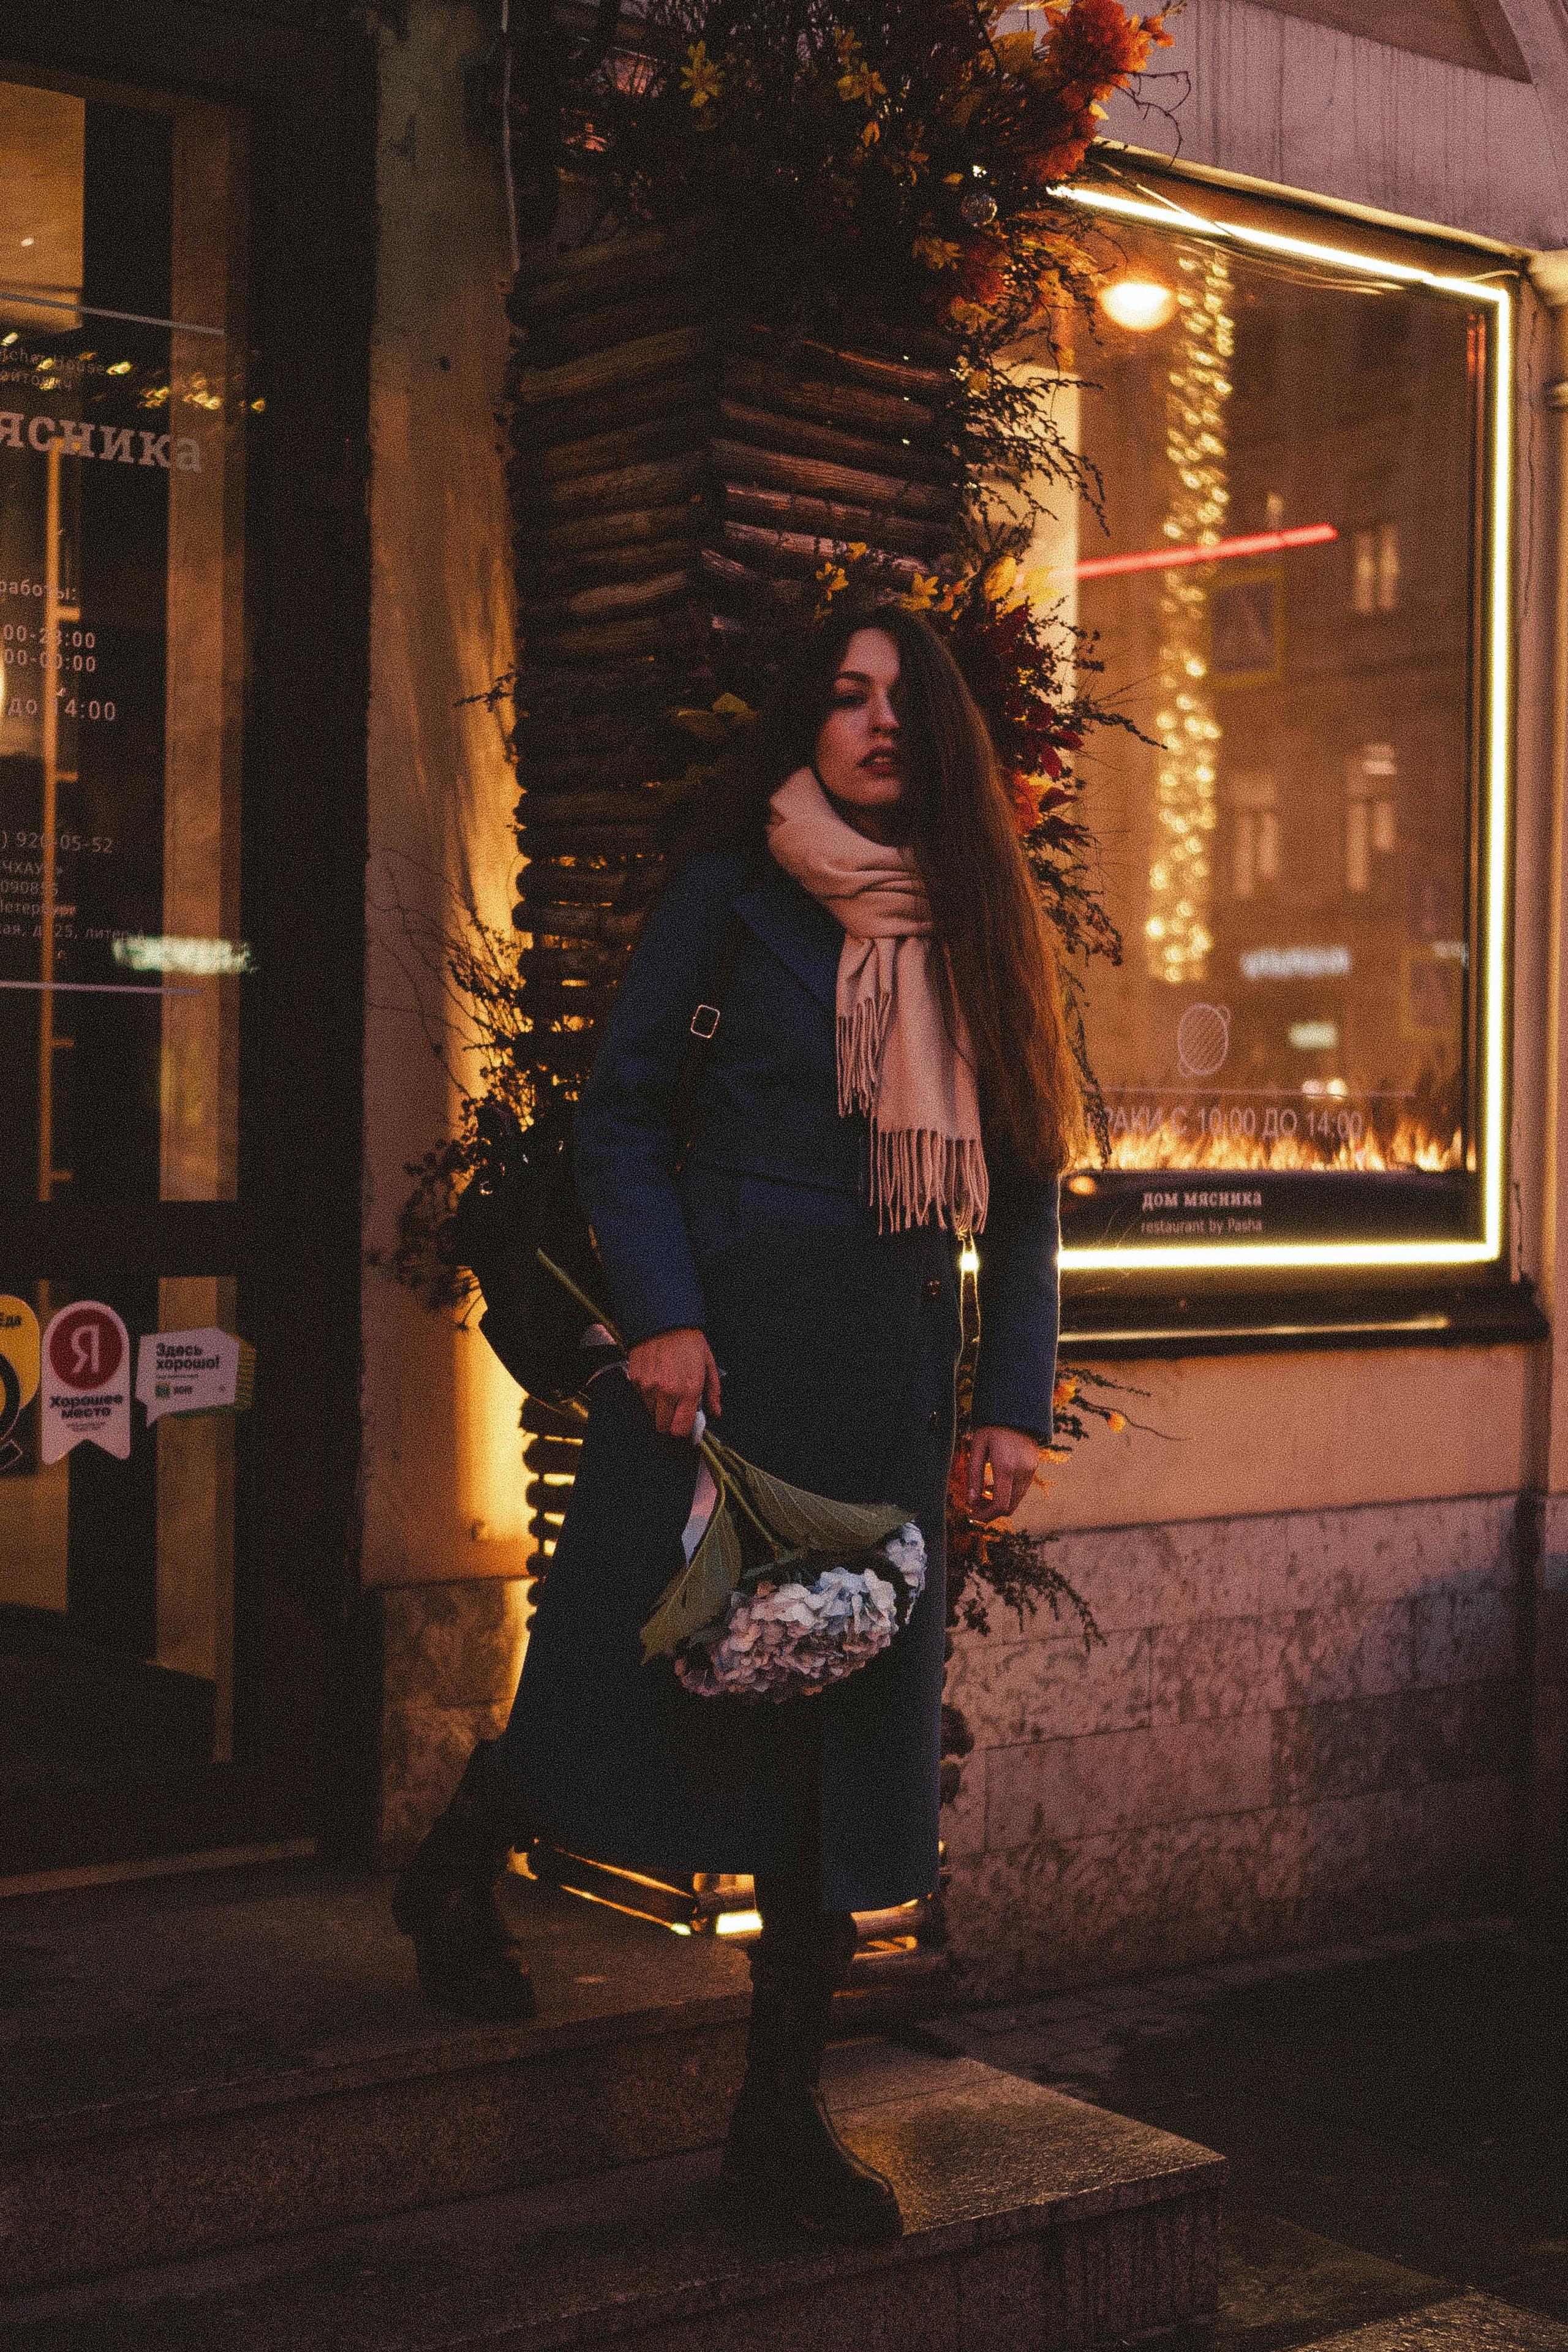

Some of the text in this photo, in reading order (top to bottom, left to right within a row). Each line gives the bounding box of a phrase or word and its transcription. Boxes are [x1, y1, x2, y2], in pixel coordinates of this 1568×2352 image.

[8, 698, 38, 717] до
[1197, 1107, 1256, 1138] 10:00
[1262, 1107, 1298, 1142] ДО
[1306, 1110, 1363, 1140] 14:00
[1183, 1190, 1262, 1208] мясника
[1141, 1216, 1263, 1235] restaurant by Pasha
[70, 1324, 100, 1375] Я
[156, 1343, 203, 1357] Здесь
[156, 1355, 220, 1371] хорошо!
[50, 1393, 123, 1410] Хорошее
[61, 1406, 111, 1419] место
